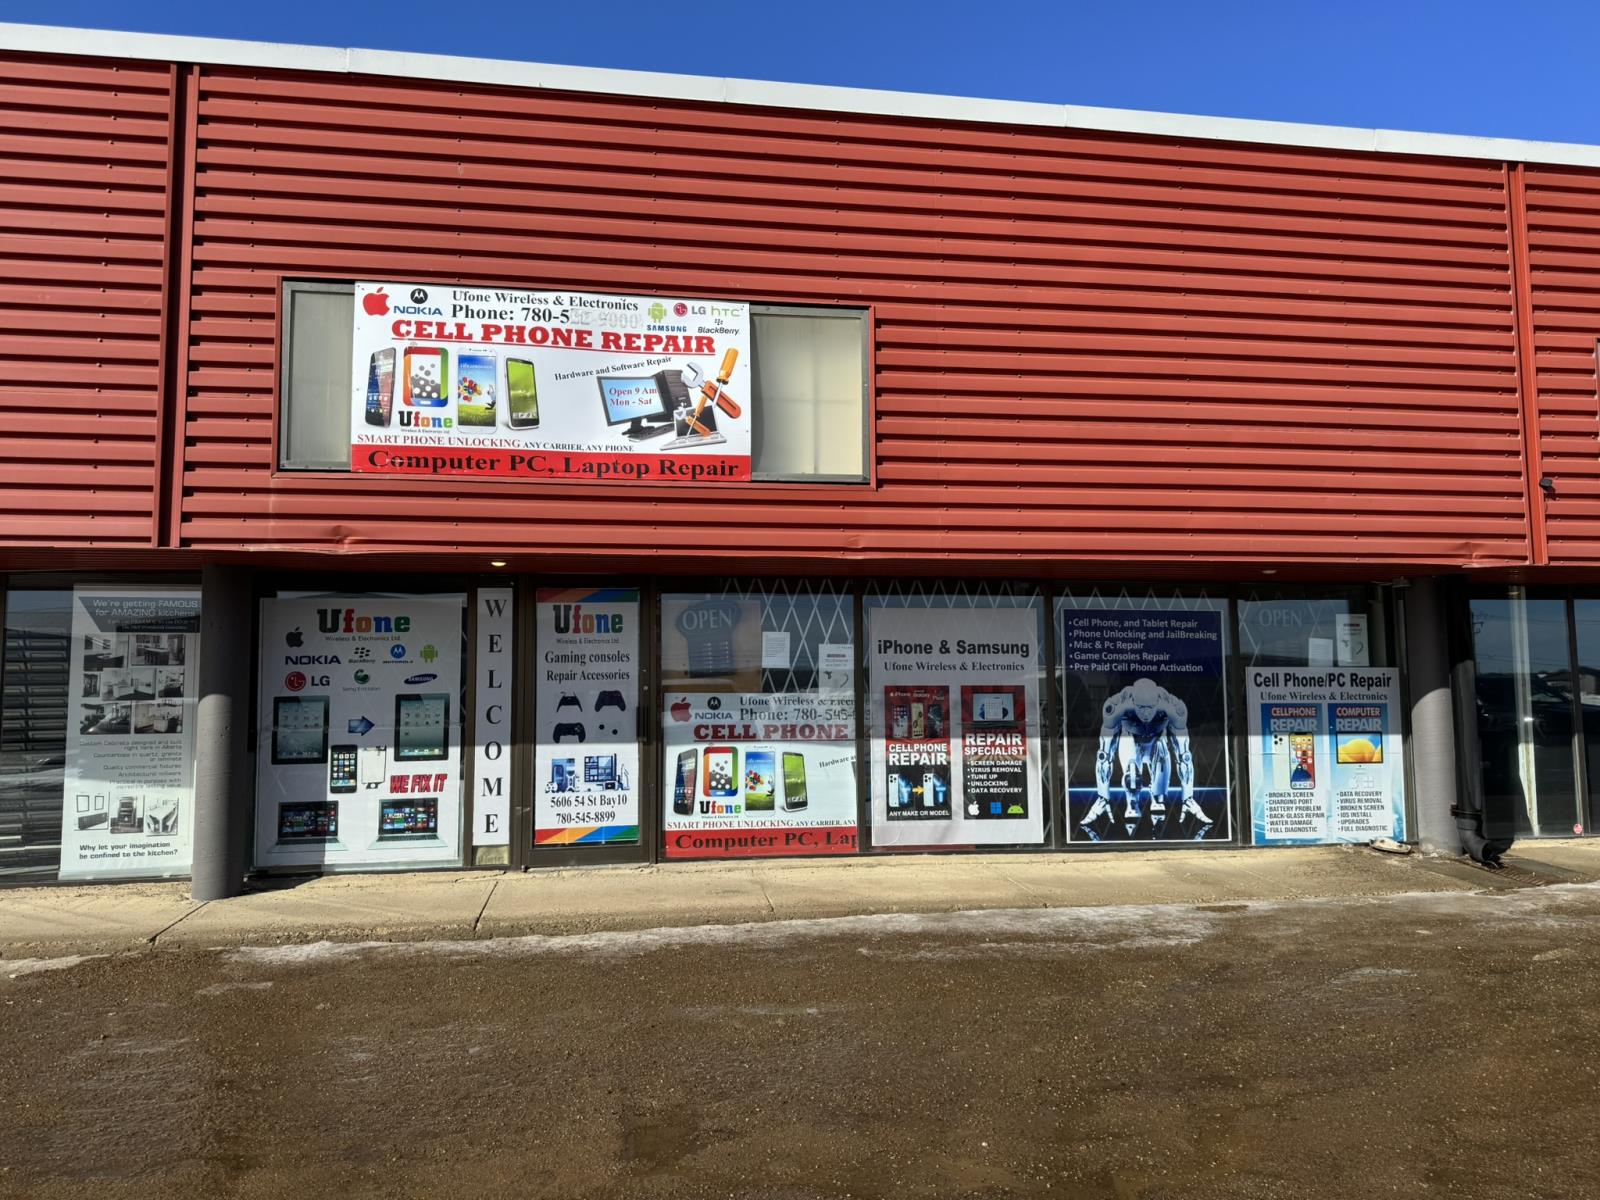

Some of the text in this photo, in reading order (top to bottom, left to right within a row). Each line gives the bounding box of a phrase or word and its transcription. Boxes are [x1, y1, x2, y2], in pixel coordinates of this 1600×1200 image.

[452, 290, 639, 311] Ufone Wireless & Electronics
[393, 305, 443, 316] NOKIA
[451, 303, 514, 321] Phone:
[691, 305, 707, 315] LG
[647, 324, 687, 333] SAMSUNG
[697, 326, 740, 336] BlackBerry
[391, 319, 716, 353] CELL PHONE REPAIR
[555, 356, 672, 381] Hardware and Software Repair
[608, 387, 633, 397] Open
[635, 386, 640, 395] 9
[609, 398, 652, 406] Mon Sat
[398, 410, 453, 428] Ufone
[357, 434, 635, 452] SMART PHONE UNLOCKING ANY CARRIER, ANY PHONE
[368, 450, 739, 480] Computer PC, Laptop Repair
[158, 600, 198, 608] FAMOUS
[111, 608, 156, 616] AMAZING
[1258, 608, 1303, 628] OPEN
[316, 608, 411, 633] Ufone
[553, 604, 624, 634] Ufone
[682, 608, 732, 630] OPEN
[1073, 618, 1198, 630] Cell Phone, and Tablet Repair
[1073, 630, 1218, 641] Phone Unlocking and JailBreaking
[878, 639, 1030, 658] iPhone & Samsung
[1073, 641, 1145, 651] Mac & Pc Repair
[285, 655, 342, 665] NOKIA
[545, 650, 630, 666] Gaming consoles
[1073, 652, 1171, 662] Game Consoles Repair
[884, 661, 1025, 671] Ufone Wireless & Electronics
[1074, 663, 1204, 672] Pre Paid Cell Phone Activation
[311, 676, 331, 687] LG
[546, 668, 630, 684] Repair Accessories
[1253, 672, 1392, 691] Cell Phone/PC Repair
[739, 696, 814, 706] Ufone Wireless
[1260, 691, 1388, 701] Ufone Wireless & Electronics
[482, 599, 507, 833] WELCOME
[694, 712, 734, 720] NOKIA
[739, 708, 788, 721] Phone:
[1271, 707, 1317, 717] CELLPHONE
[1336, 707, 1381, 717] COMPUTER
[1270, 718, 1318, 732] REPAIR
[1335, 718, 1382, 732] REPAIR
[693, 724, 849, 740] CELL PHONE
[965, 733, 1022, 746] REPAIR
[889, 743, 947, 753] CELLPHONE
[964, 746, 1025, 756] SPECIALIST
[819, 755, 849, 769] Hardware
[889, 752, 947, 766] REPAIR
[390, 773, 448, 794] WE FIX IT
[550, 796, 572, 808] 5606
[574, 796, 585, 807] 54
[587, 795, 597, 807] St
[699, 801, 742, 815] Ufone
[555, 811, 616, 825] 780-545-8899
[666, 821, 701, 829] SMART
[702, 820, 735, 829] PHONE
[737, 819, 794, 828] UNLOCKING
[79, 844, 96, 852] Why
[129, 842, 171, 850] imagination
[675, 832, 819, 851] Computer PC,
[147, 849, 178, 857] kitchen?
